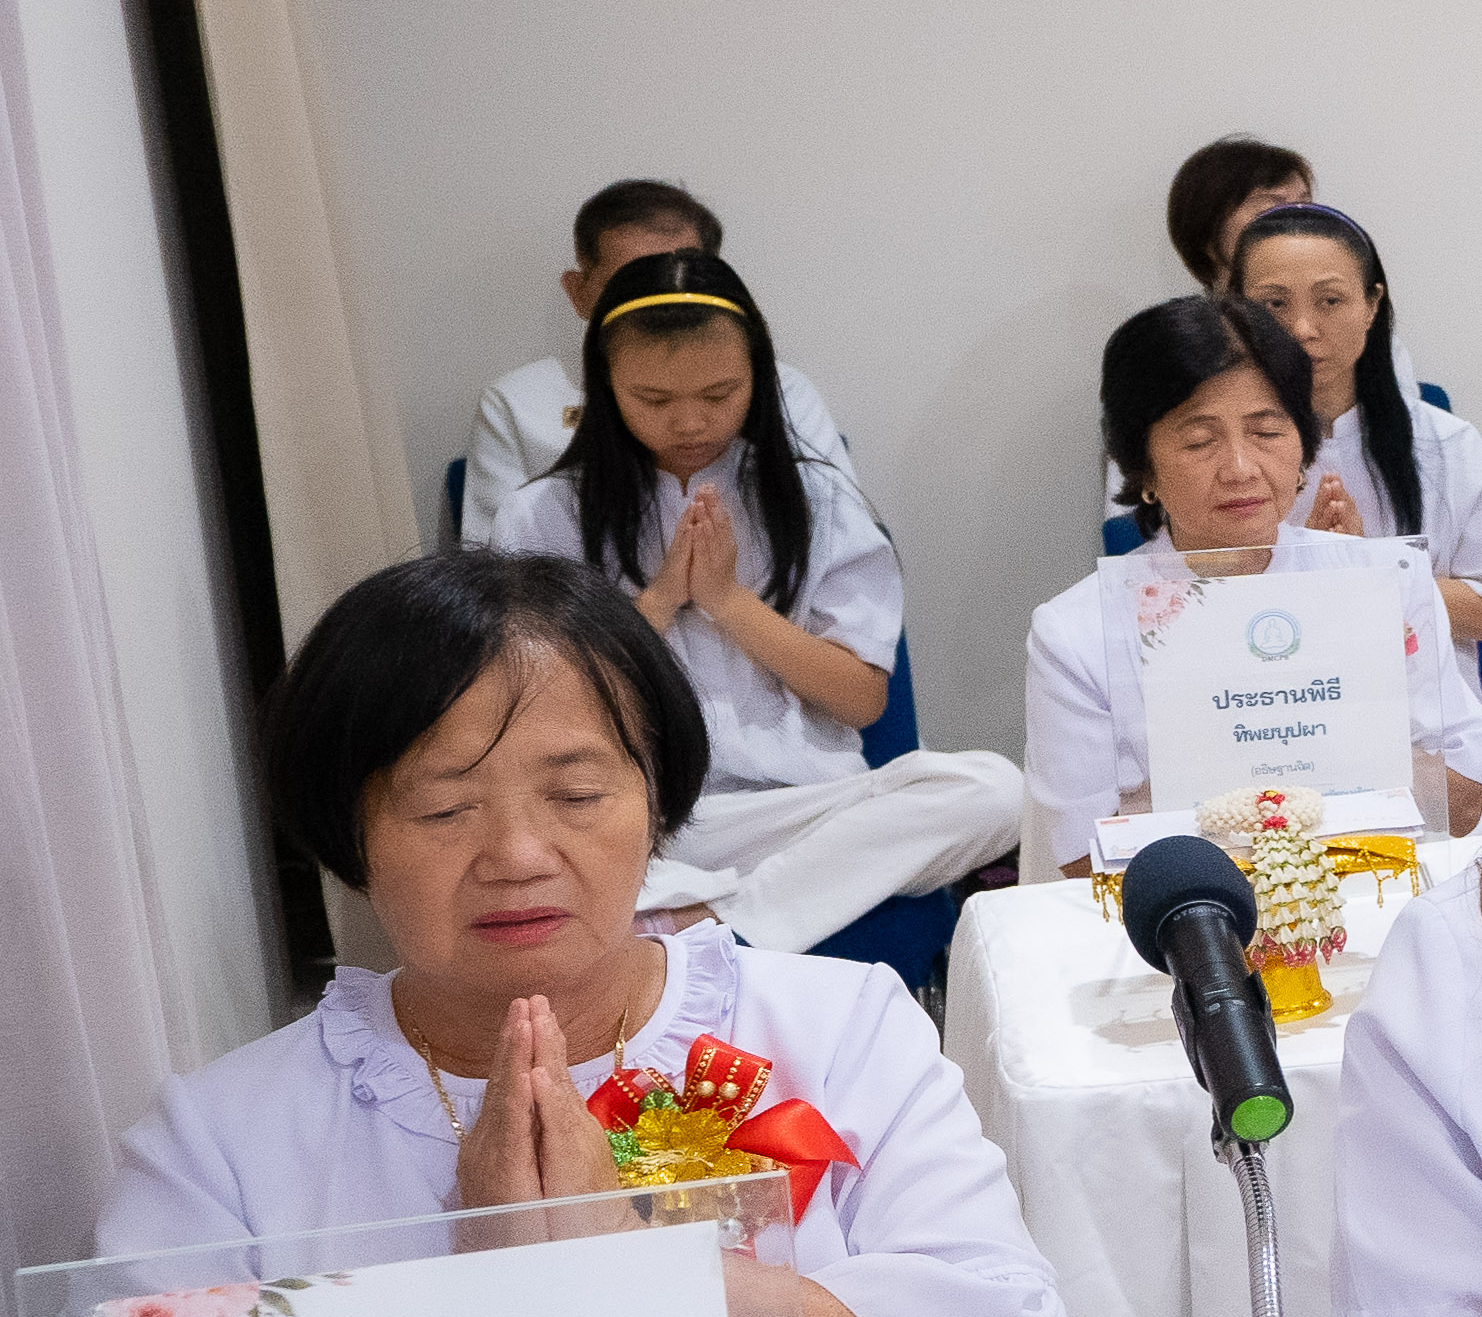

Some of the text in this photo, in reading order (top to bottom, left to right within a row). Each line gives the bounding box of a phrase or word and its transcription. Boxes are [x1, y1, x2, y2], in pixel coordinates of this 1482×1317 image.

[1212, 677, 1342, 710] ประธานพิธี
[1233, 721, 1327, 746] ทิพยบุปผา
